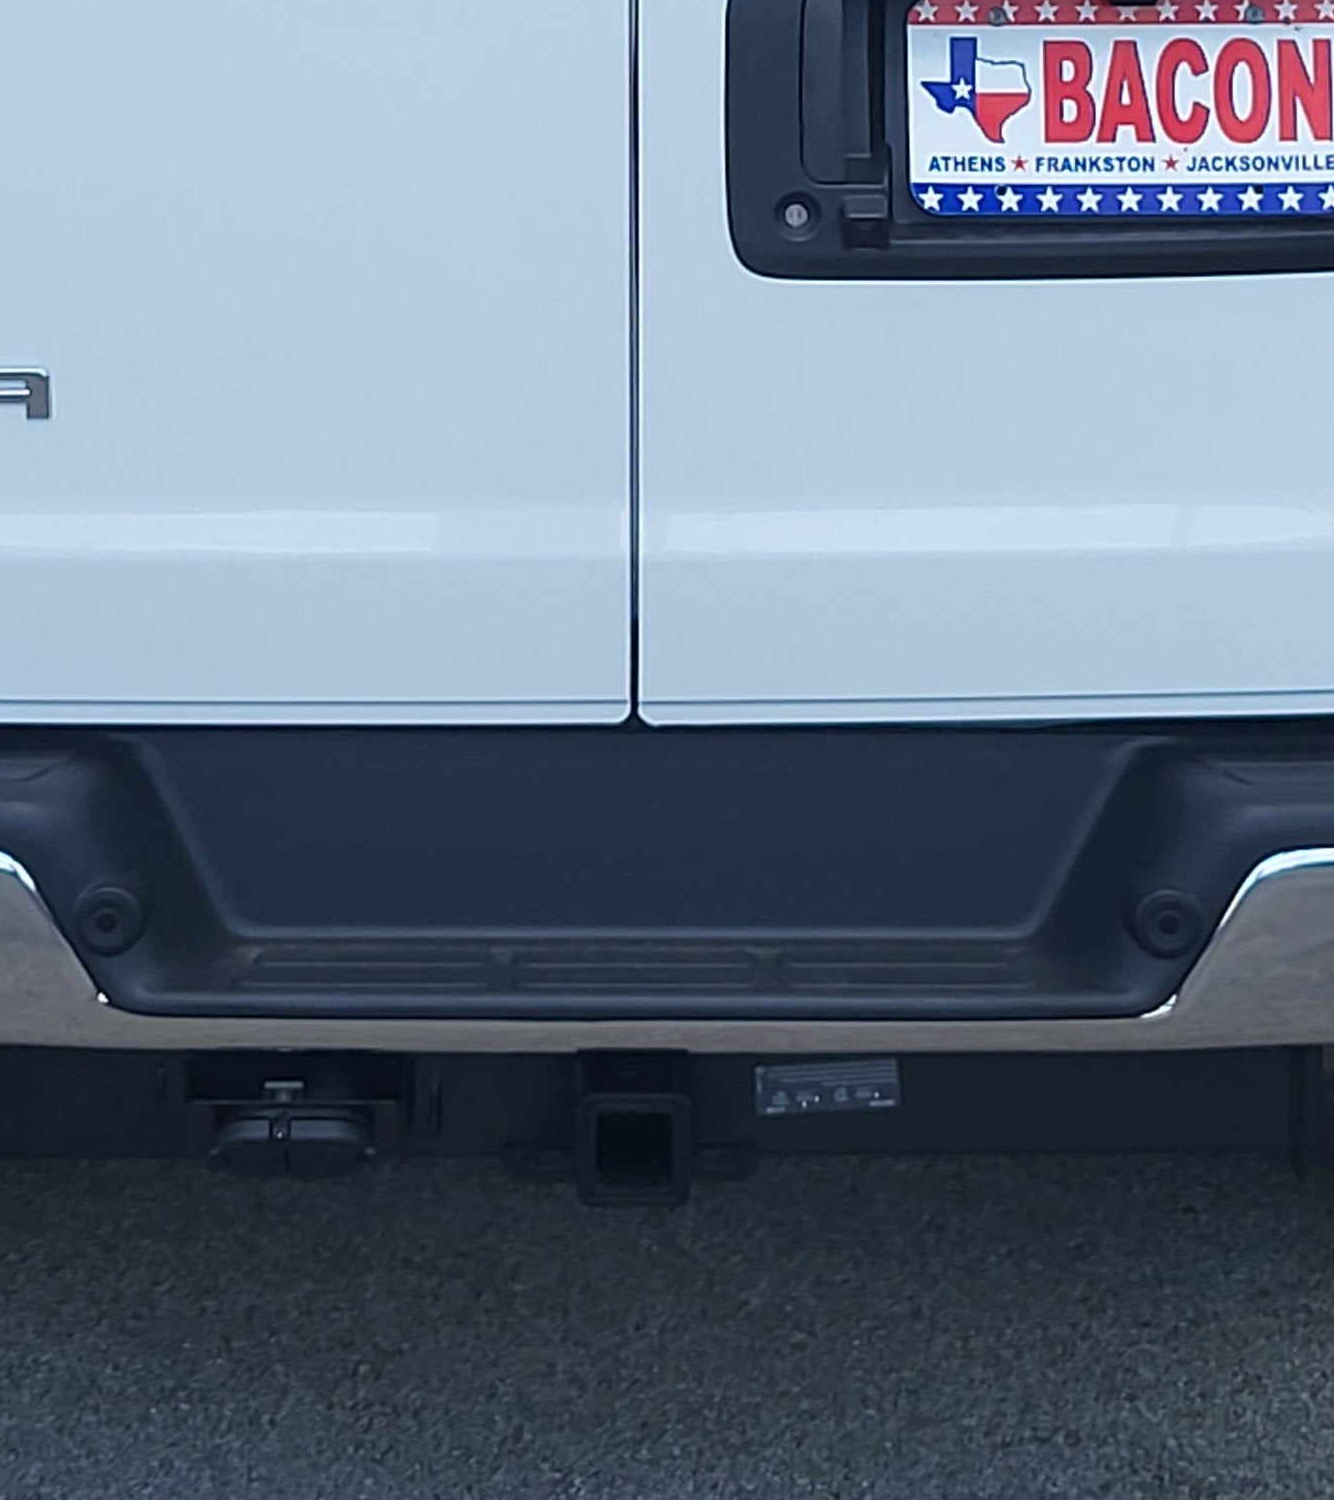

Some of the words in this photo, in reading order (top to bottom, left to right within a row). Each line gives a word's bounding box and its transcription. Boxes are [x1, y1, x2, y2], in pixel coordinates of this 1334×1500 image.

[1042, 37, 1334, 144] BACON
[928, 155, 1007, 173] ATHENS
[1035, 155, 1156, 173] FRANKSTON
